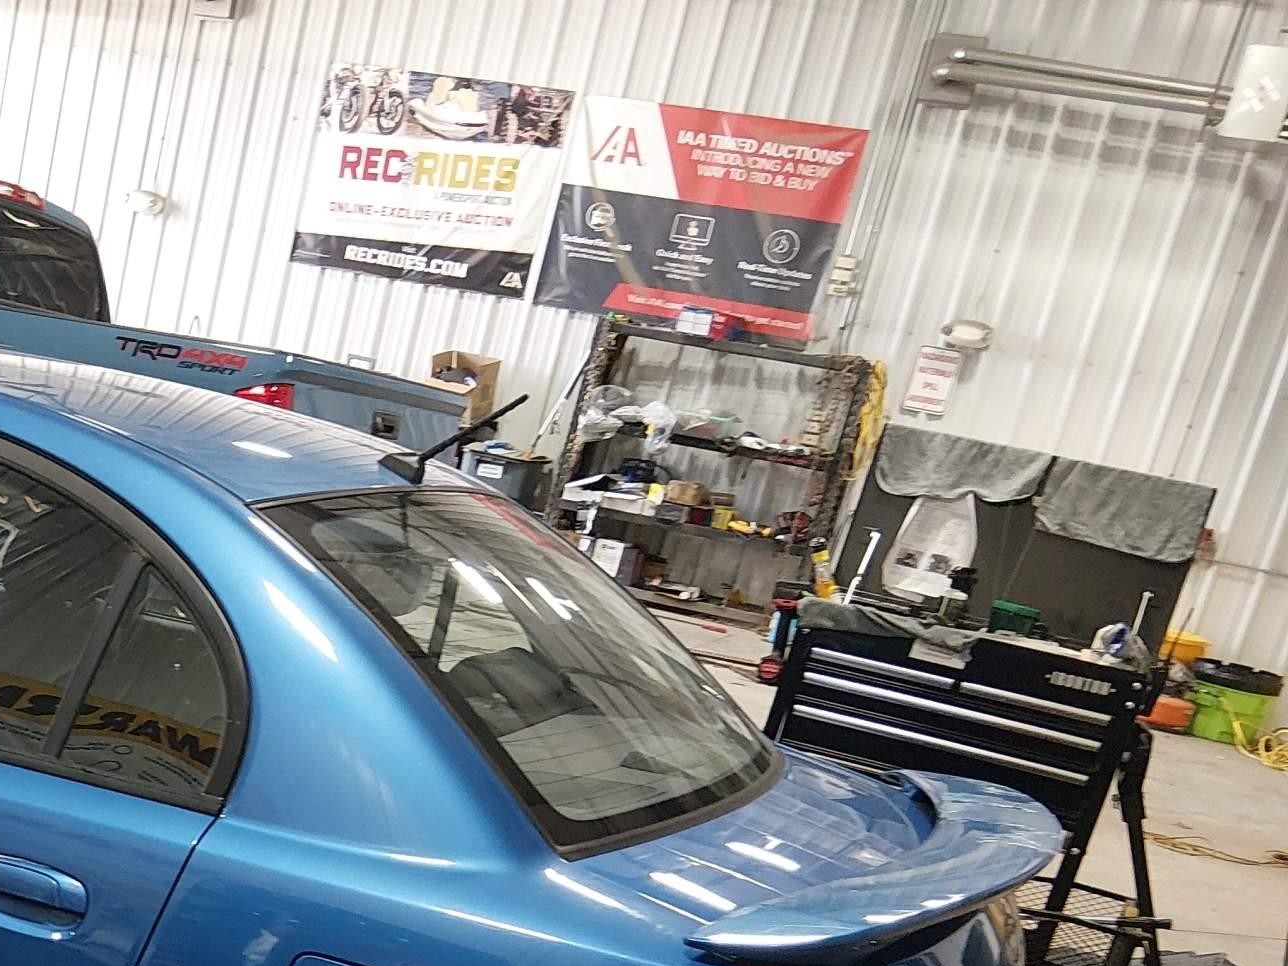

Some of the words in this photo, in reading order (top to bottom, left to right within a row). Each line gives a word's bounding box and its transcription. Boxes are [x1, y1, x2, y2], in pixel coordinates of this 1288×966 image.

[676, 129, 708, 148] IAA
[709, 133, 760, 154] TIMED
[338, 145, 407, 184] REC
[414, 151, 521, 193] RIDES
[690, 148, 781, 173] INTRODUCING
[781, 159, 795, 174] A
[797, 161, 833, 179] NEW
[696, 164, 727, 180] WAY
[727, 166, 748, 182] TO
[747, 171, 773, 186] BID
[773, 174, 787, 188] &
[787, 175, 820, 191] BUY
[457, 213, 515, 228] AUCTION
[343, 244, 469, 279] RECRIDES.COM
[115, 335, 182, 361] TRD
[177, 360, 244, 376] SPORT
